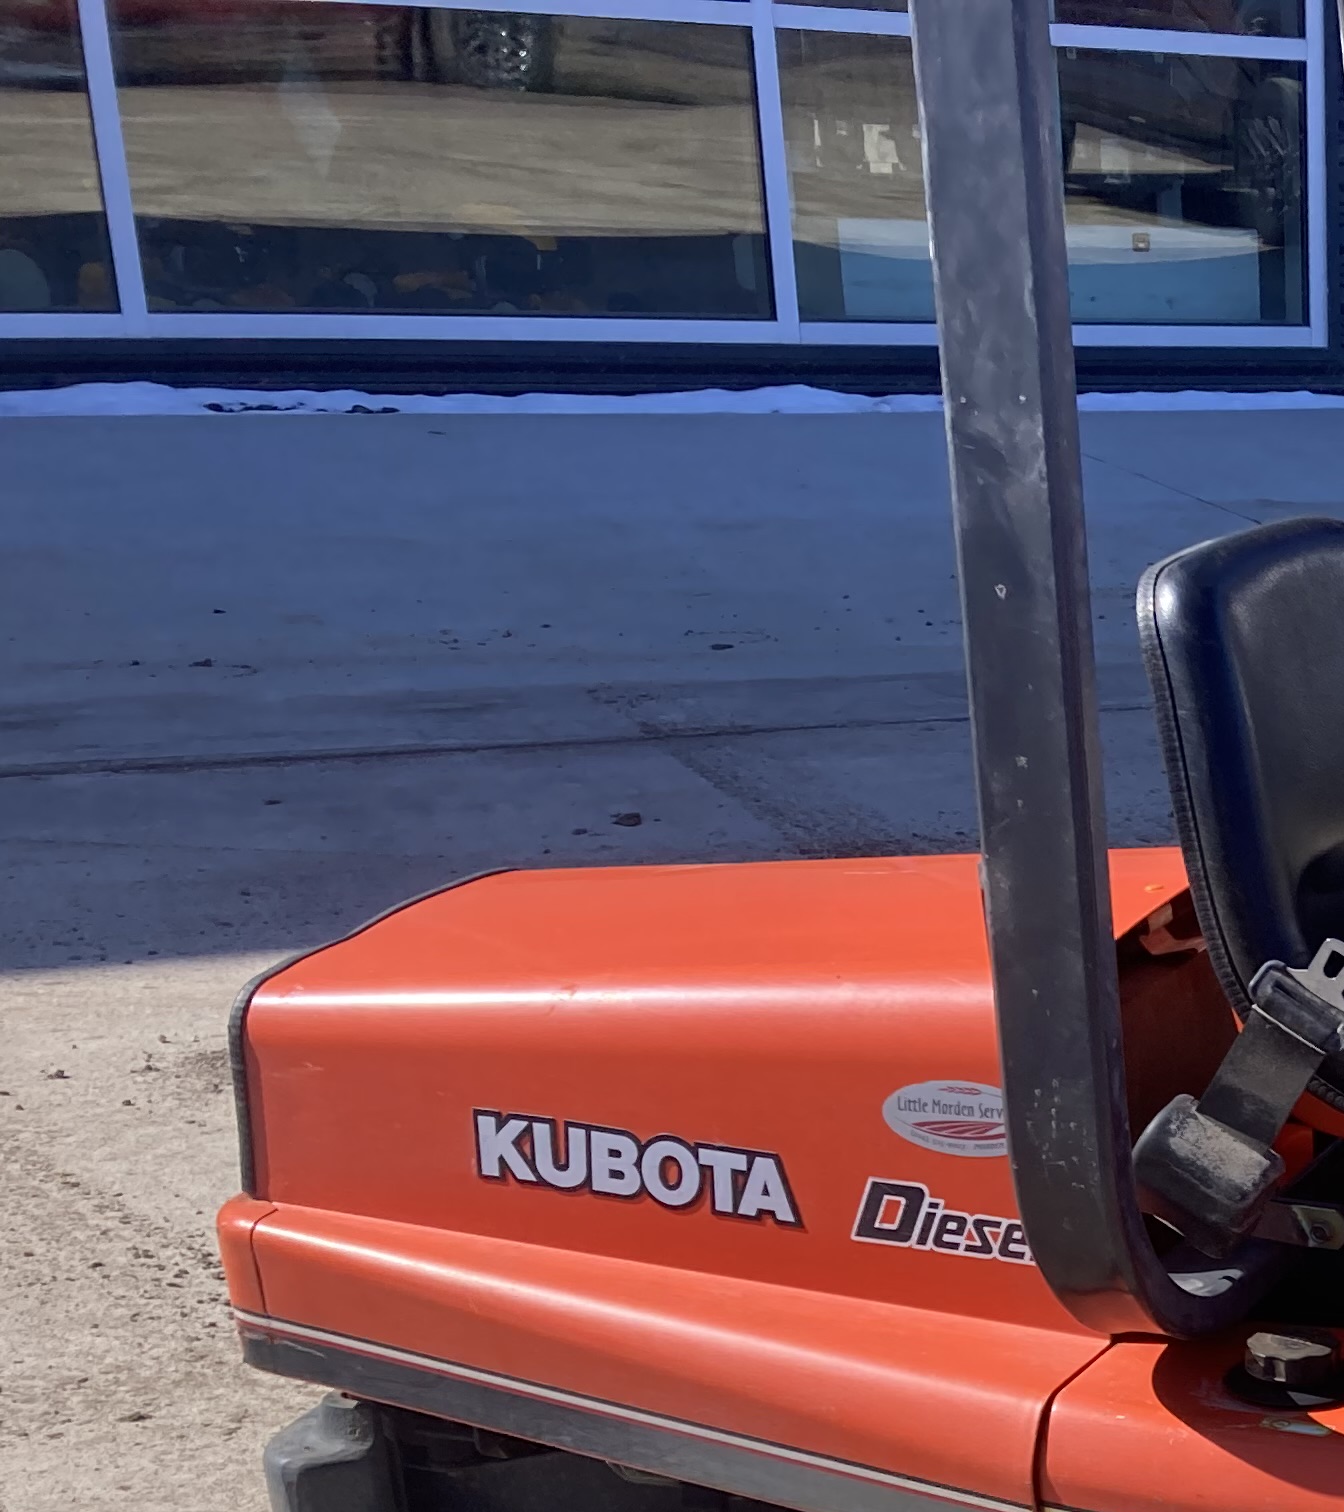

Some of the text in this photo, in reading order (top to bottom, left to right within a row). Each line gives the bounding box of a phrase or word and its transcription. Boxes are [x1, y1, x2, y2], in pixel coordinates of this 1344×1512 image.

[897, 1095, 929, 1114] Little
[931, 1098, 975, 1117] Morden
[473, 1108, 804, 1230] KUBOTA
[852, 1178, 1036, 1264] Diese
